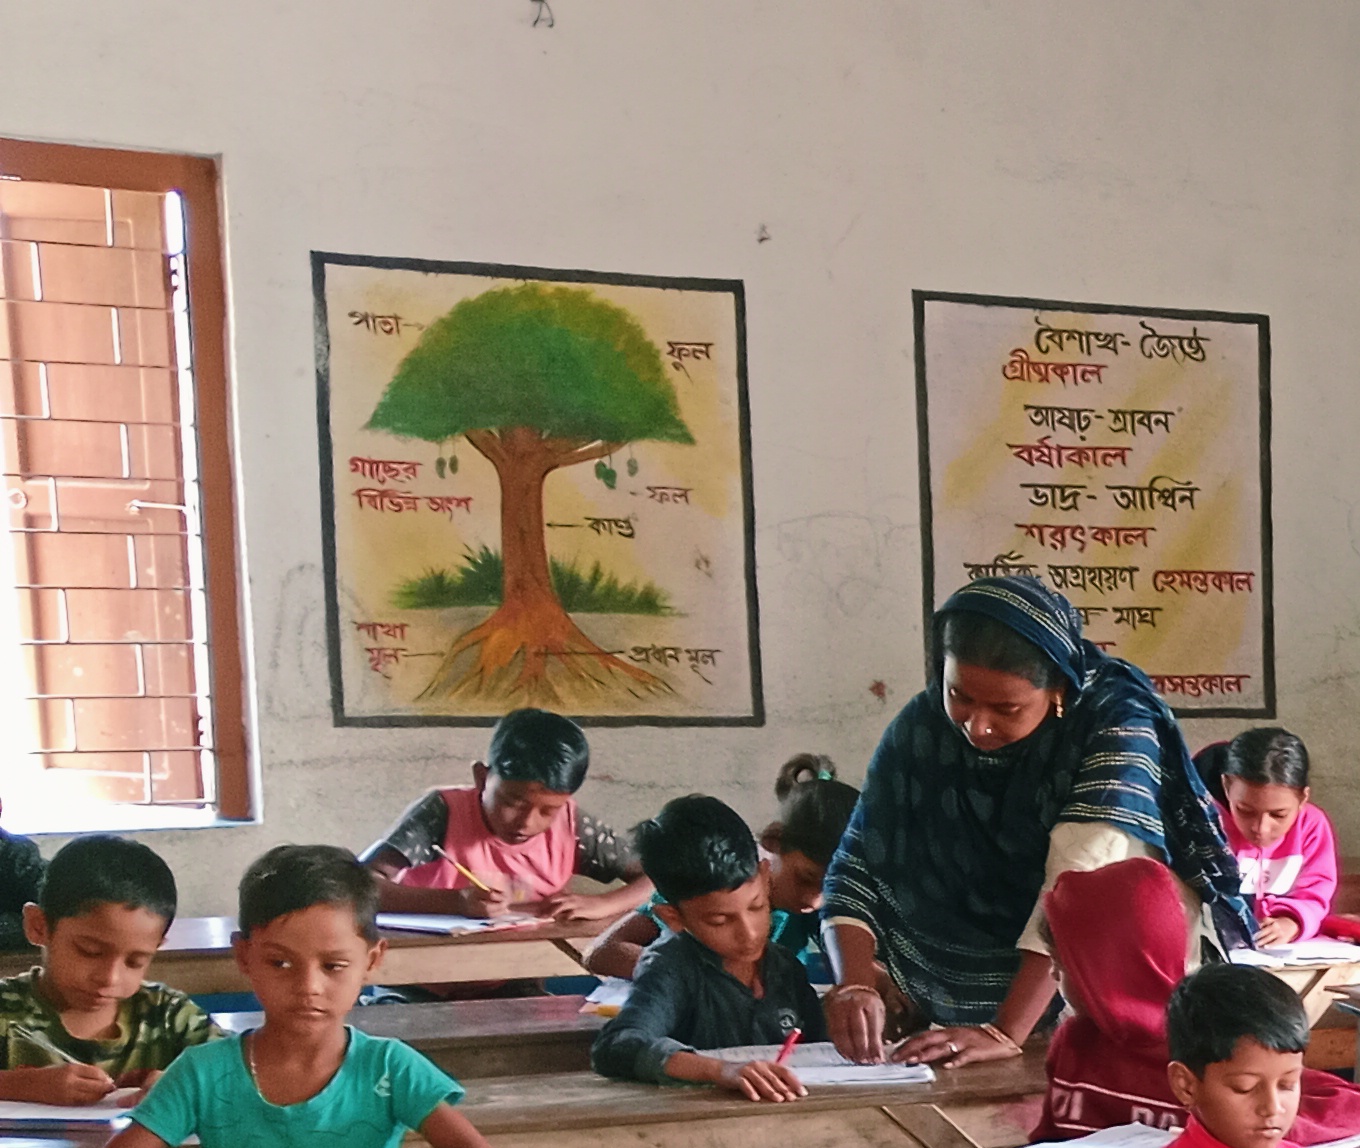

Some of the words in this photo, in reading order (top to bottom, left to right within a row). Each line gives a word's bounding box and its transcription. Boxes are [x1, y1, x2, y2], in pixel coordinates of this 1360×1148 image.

[348, 310, 402, 336] পাতা
[666, 341, 714, 384] ফুল
[1006, 435, 1133, 469] বর্ষাকাল
[349, 455, 423, 485] গাছের
[645, 485, 693, 505] ফল
[1047, 564, 1140, 595] অগ্রহায়ণ
[1153, 569, 1256, 595] হেমন্তকাল
[1112, 606, 1164, 631] মাঘ
